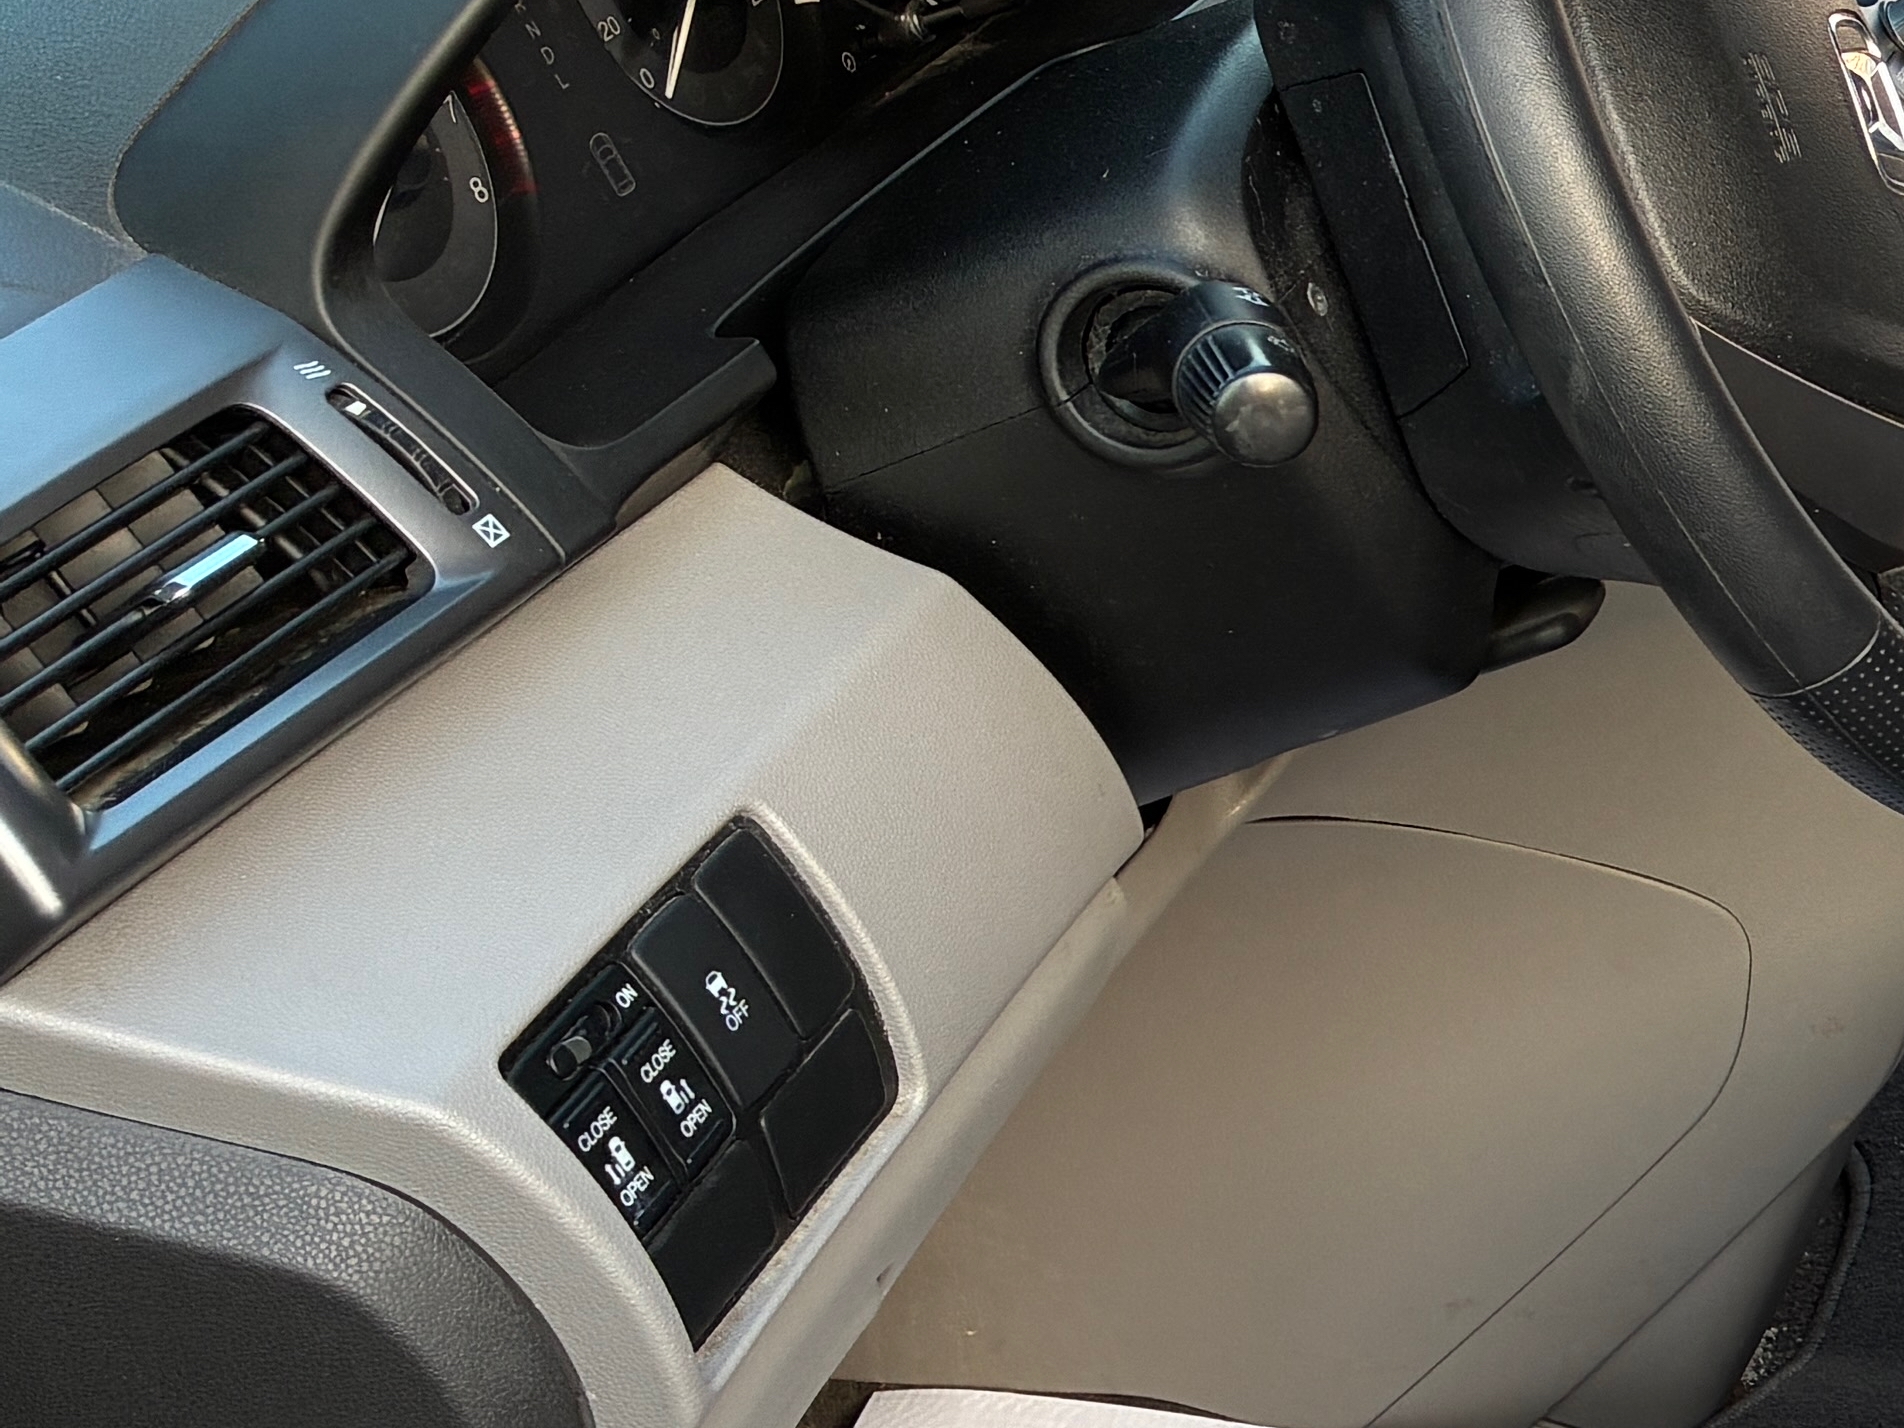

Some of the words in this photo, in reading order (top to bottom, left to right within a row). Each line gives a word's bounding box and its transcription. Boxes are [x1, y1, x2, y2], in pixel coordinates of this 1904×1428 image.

[524, 20, 541, 40] N
[597, 15, 621, 42] 20
[540, 46, 555, 65] D
[554, 73, 570, 89] L
[640, 67, 655, 89] 0
[469, 176, 489, 204] 8
[616, 983, 639, 1009] ON
[724, 999, 751, 1032] OFF
[640, 1039, 677, 1084] CLOSE
[577, 1106, 618, 1153] CLOSE
[679, 1099, 713, 1138] OPEN
[619, 1166, 655, 1207] OPEN
